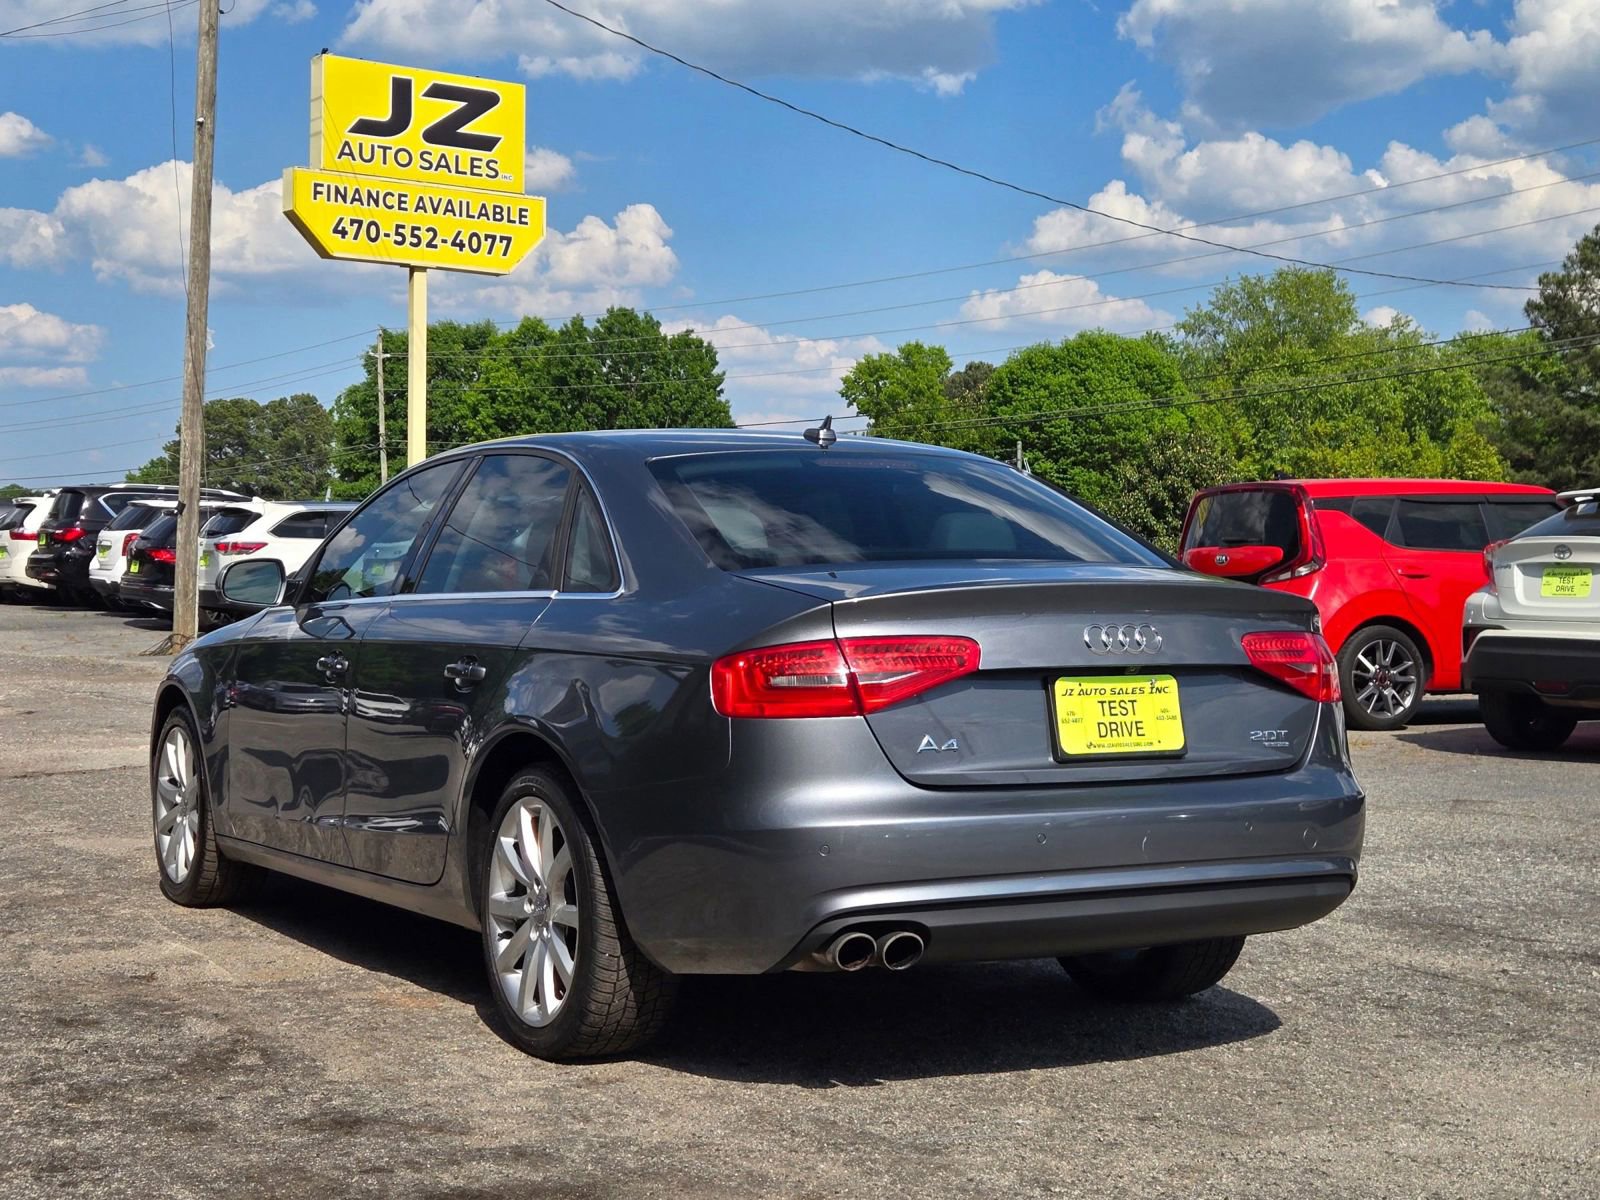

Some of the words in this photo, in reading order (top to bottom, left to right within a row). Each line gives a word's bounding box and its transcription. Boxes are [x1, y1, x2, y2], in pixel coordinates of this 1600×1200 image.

[347, 76, 502, 152] JZ
[337, 140, 414, 168] AUTO
[419, 150, 499, 179] SALES
[313, 182, 408, 211] FINANCE
[414, 196, 529, 226] AVAILABLE
[332, 217, 513, 257] 470-552-4077
[1559, 576, 1575, 584] TEST
[1062, 688, 1074, 697] JZ
[1078, 687, 1106, 696] AUTO
[1110, 686, 1145, 696] SALES
[1097, 699, 1137, 717] TEST
[1097, 721, 1145, 738] DRIVE
[917, 734, 959, 753] A4
